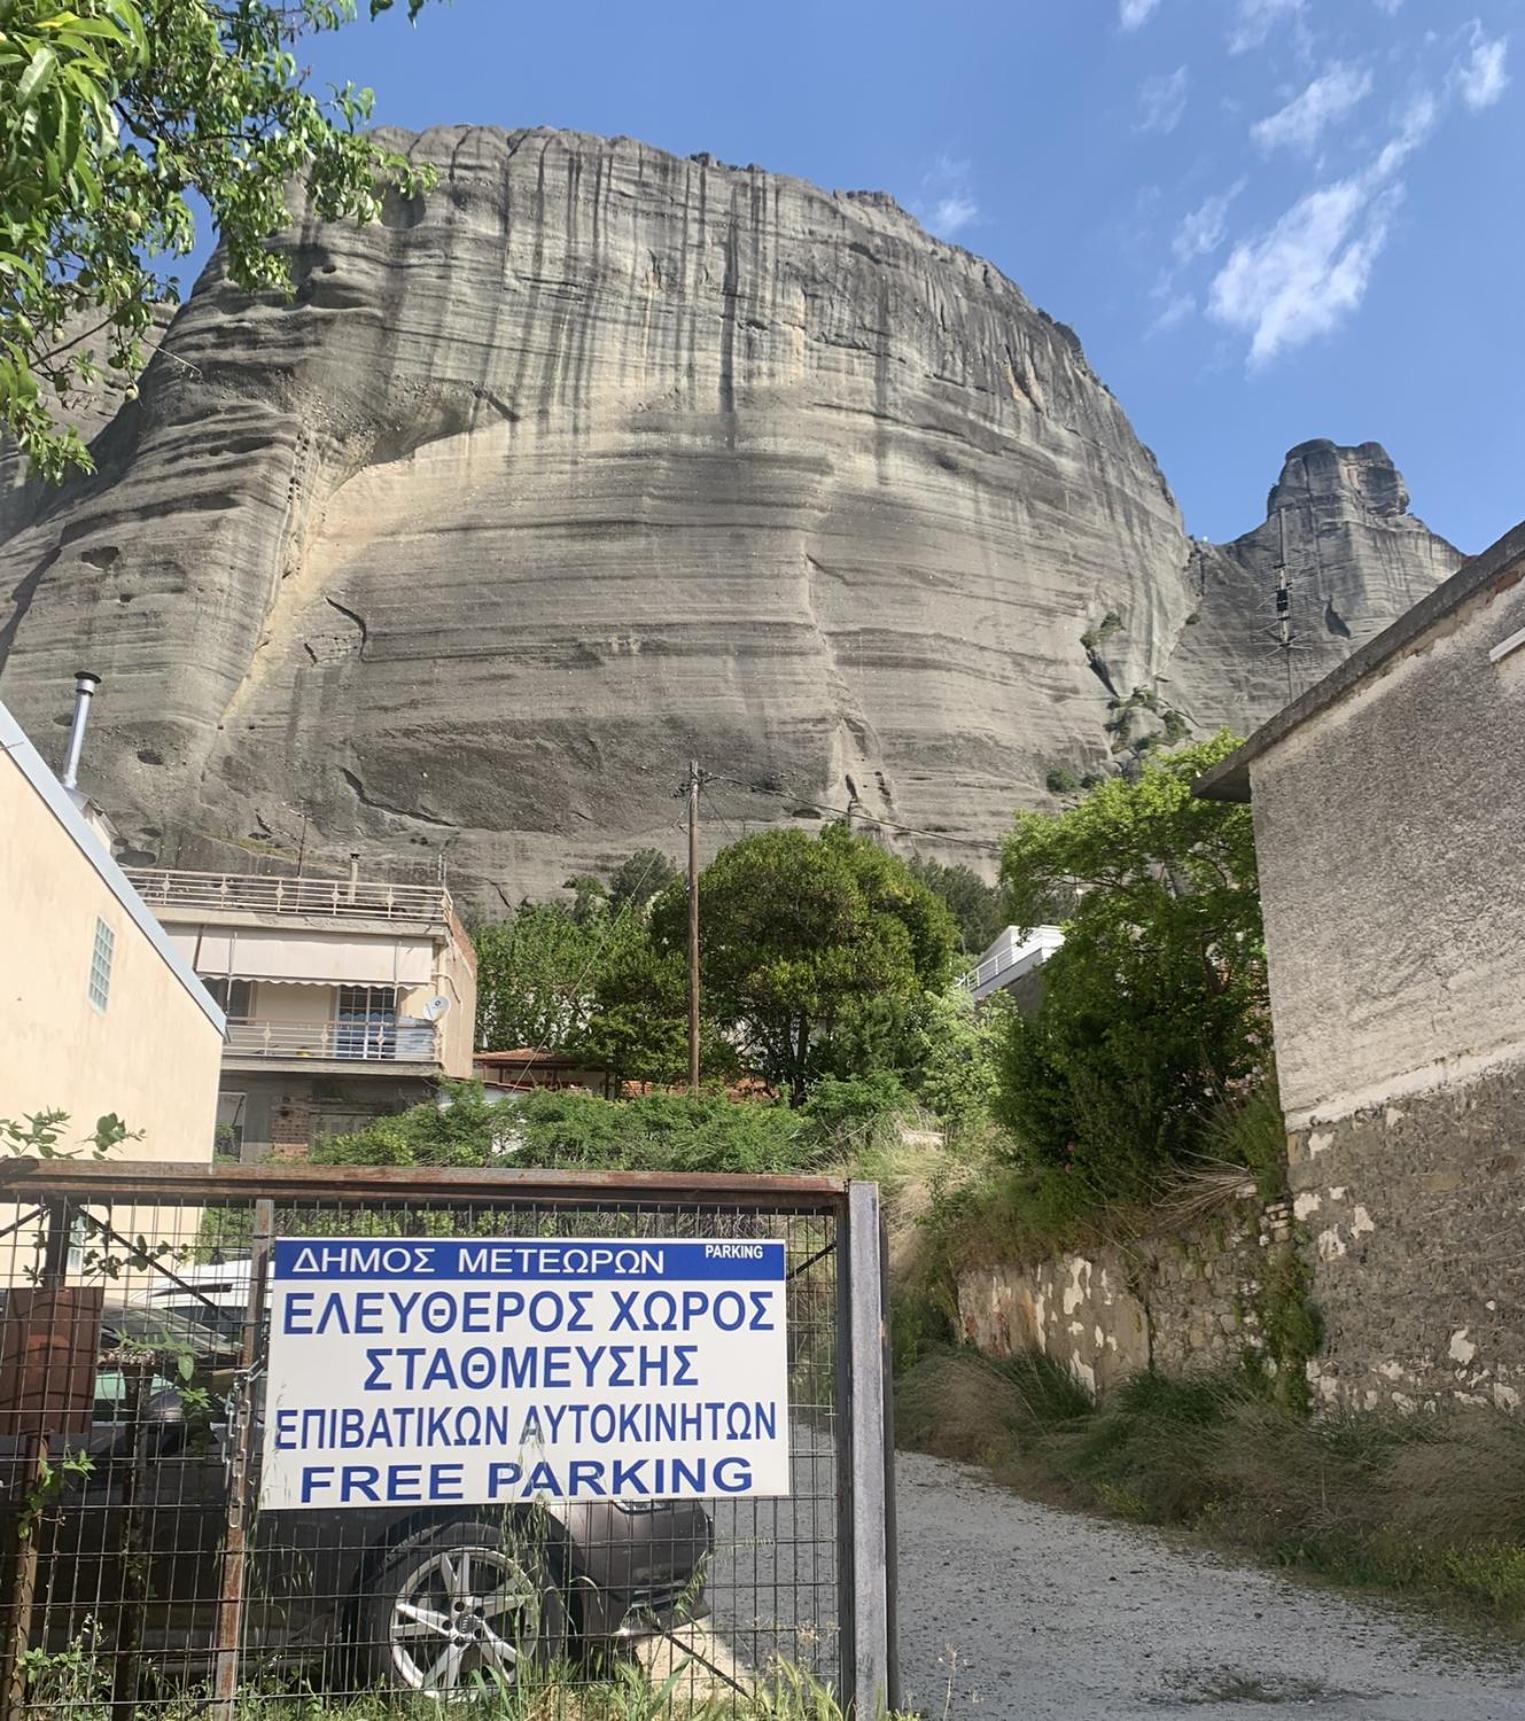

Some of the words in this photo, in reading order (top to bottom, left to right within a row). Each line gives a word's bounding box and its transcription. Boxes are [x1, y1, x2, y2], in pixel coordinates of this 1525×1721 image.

[292, 1247, 435, 1273] ΔΗΜΟΣ
[458, 1248, 664, 1274] ΜΕΤΕΩΡΩΝ
[705, 1244, 764, 1260] PARKING
[283, 1290, 593, 1335] ΕΛΕΥΘΕΡΟΣ
[609, 1290, 774, 1332] ΧΩΡΟΣ
[363, 1344, 699, 1392] ΣΤΑΘΜΕΥΣΗΣ
[275, 1406, 508, 1450] ΕΠΙΒΑΤΙΚΩΝ
[519, 1402, 776, 1446] ΑΥΤΟΚΙΝΗΤΩΝ
[300, 1463, 464, 1503] FREE
[487, 1456, 753, 1499] PARKING
